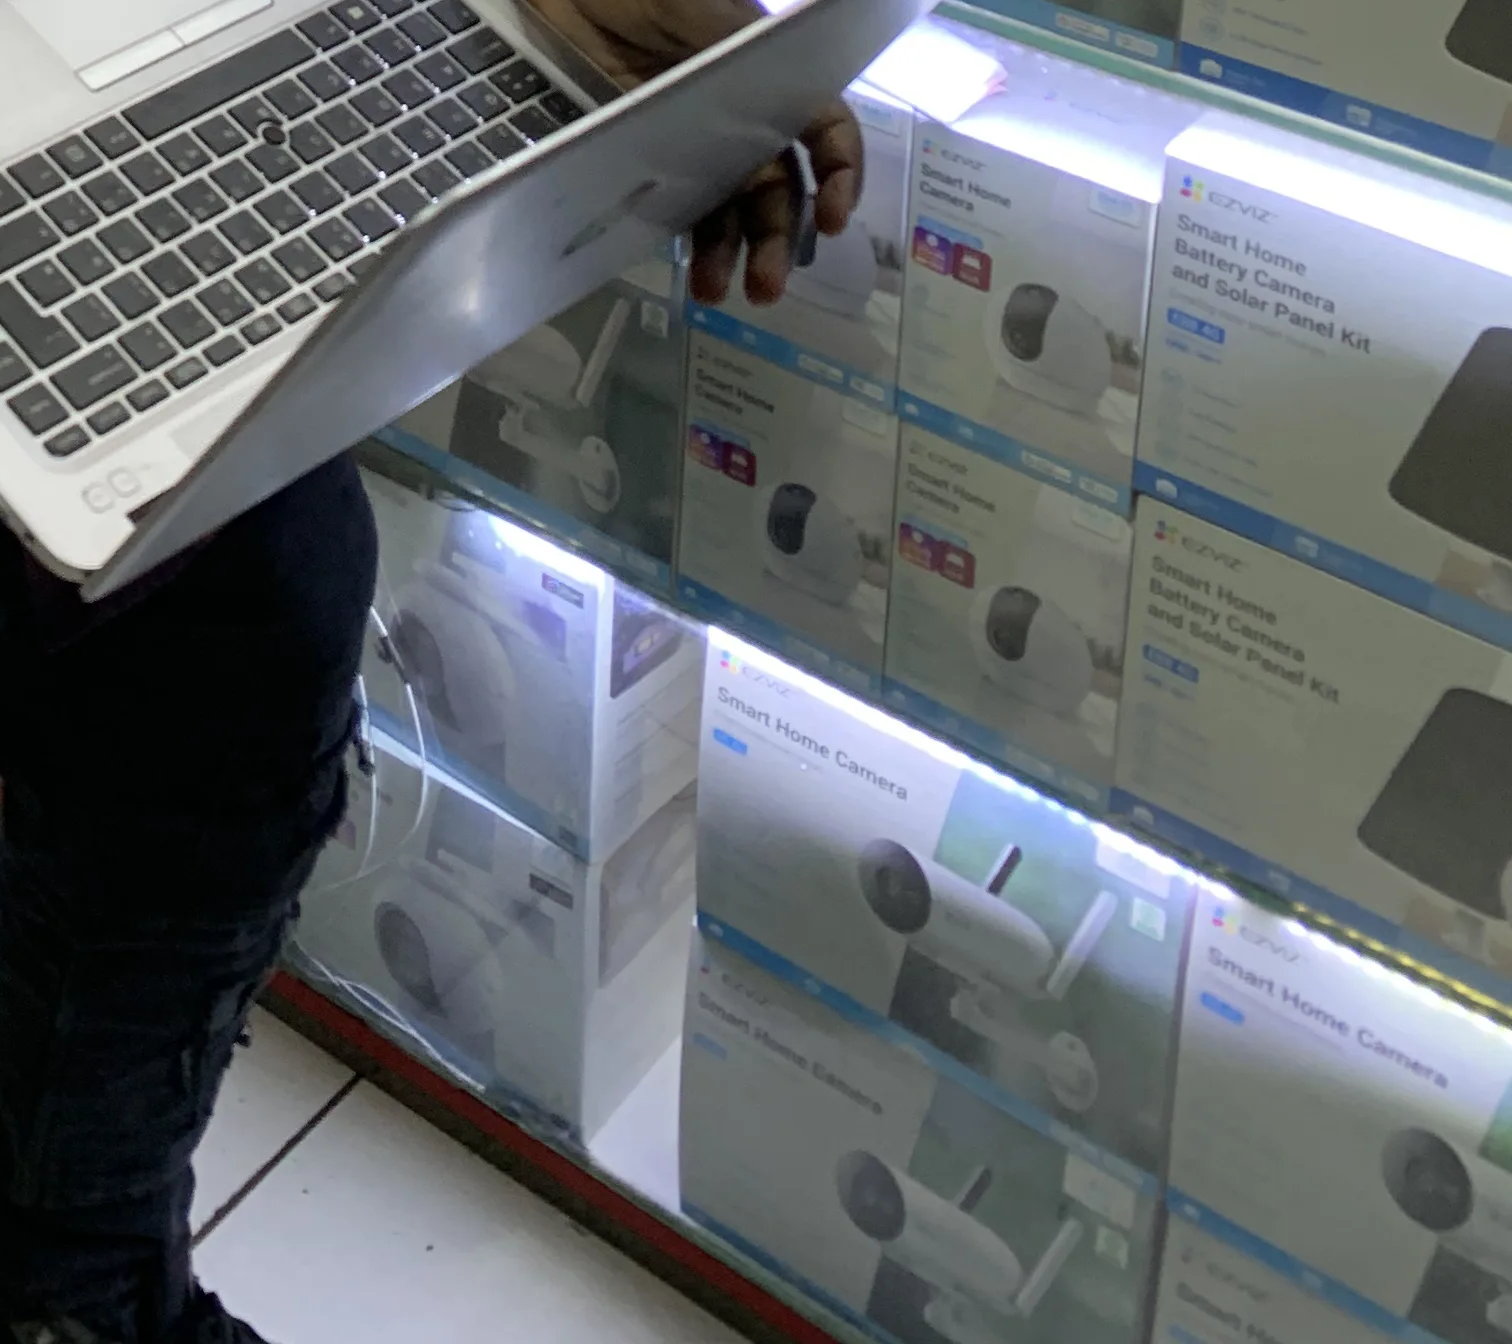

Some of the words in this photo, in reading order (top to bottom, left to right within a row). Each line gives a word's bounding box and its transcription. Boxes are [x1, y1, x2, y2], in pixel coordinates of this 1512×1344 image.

[716, 686, 772, 727] Smart
[775, 717, 831, 760] Home
[835, 751, 909, 801] Camera
